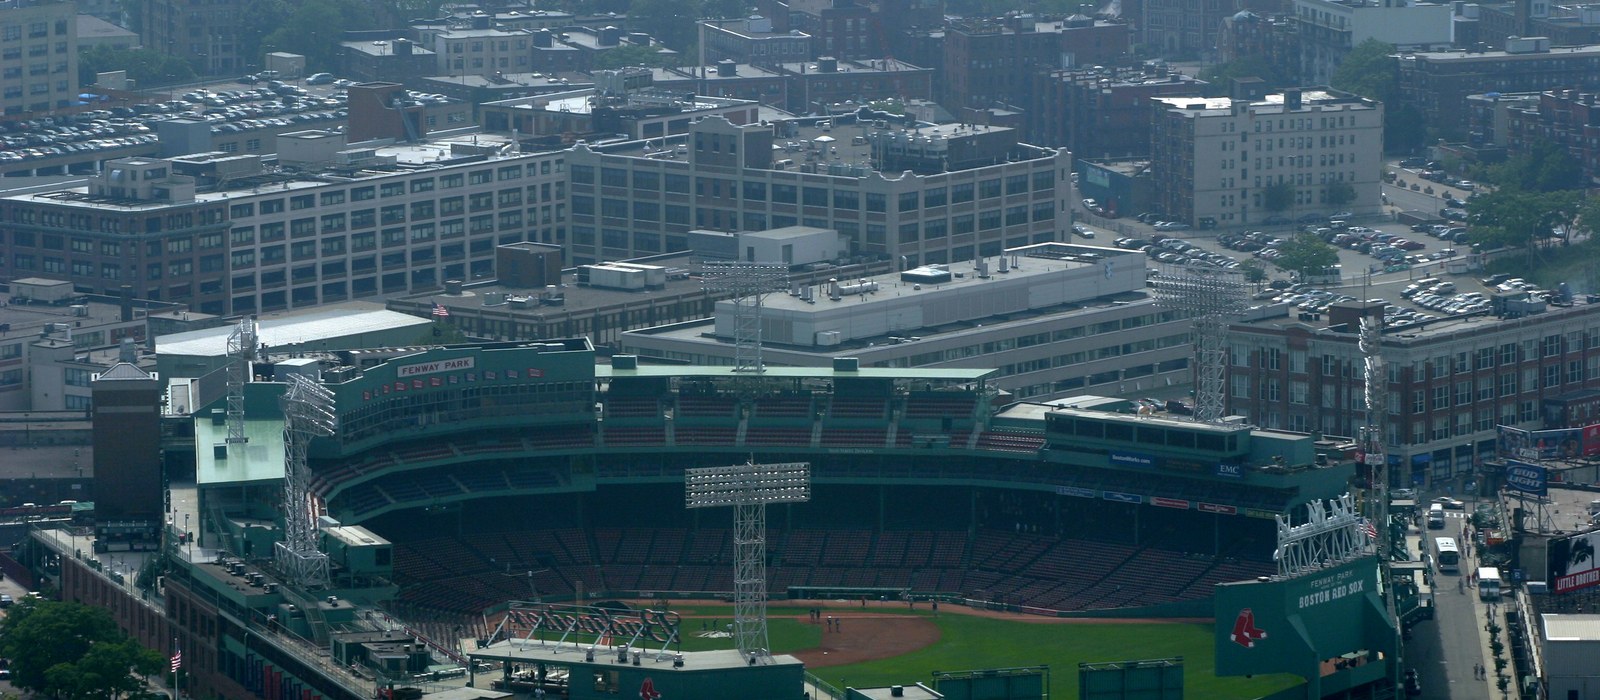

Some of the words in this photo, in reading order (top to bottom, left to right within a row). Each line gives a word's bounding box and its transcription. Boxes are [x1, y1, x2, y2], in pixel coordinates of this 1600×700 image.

[402, 363, 440, 374] FENWAY
[445, 360, 470, 368] PARK
[1514, 468, 1538, 478] BUD
[1510, 476, 1543, 487] LIGHT
[1312, 576, 1334, 587] FENWAY
[1338, 570, 1353, 580] PARK
[1557, 575, 1574, 590] LITTLE
[1575, 570, 1600, 585] BROTHER
[1299, 590, 1330, 608] BOSTON
[1332, 587, 1346, 599] RED
[1348, 580, 1363, 594] SOX
